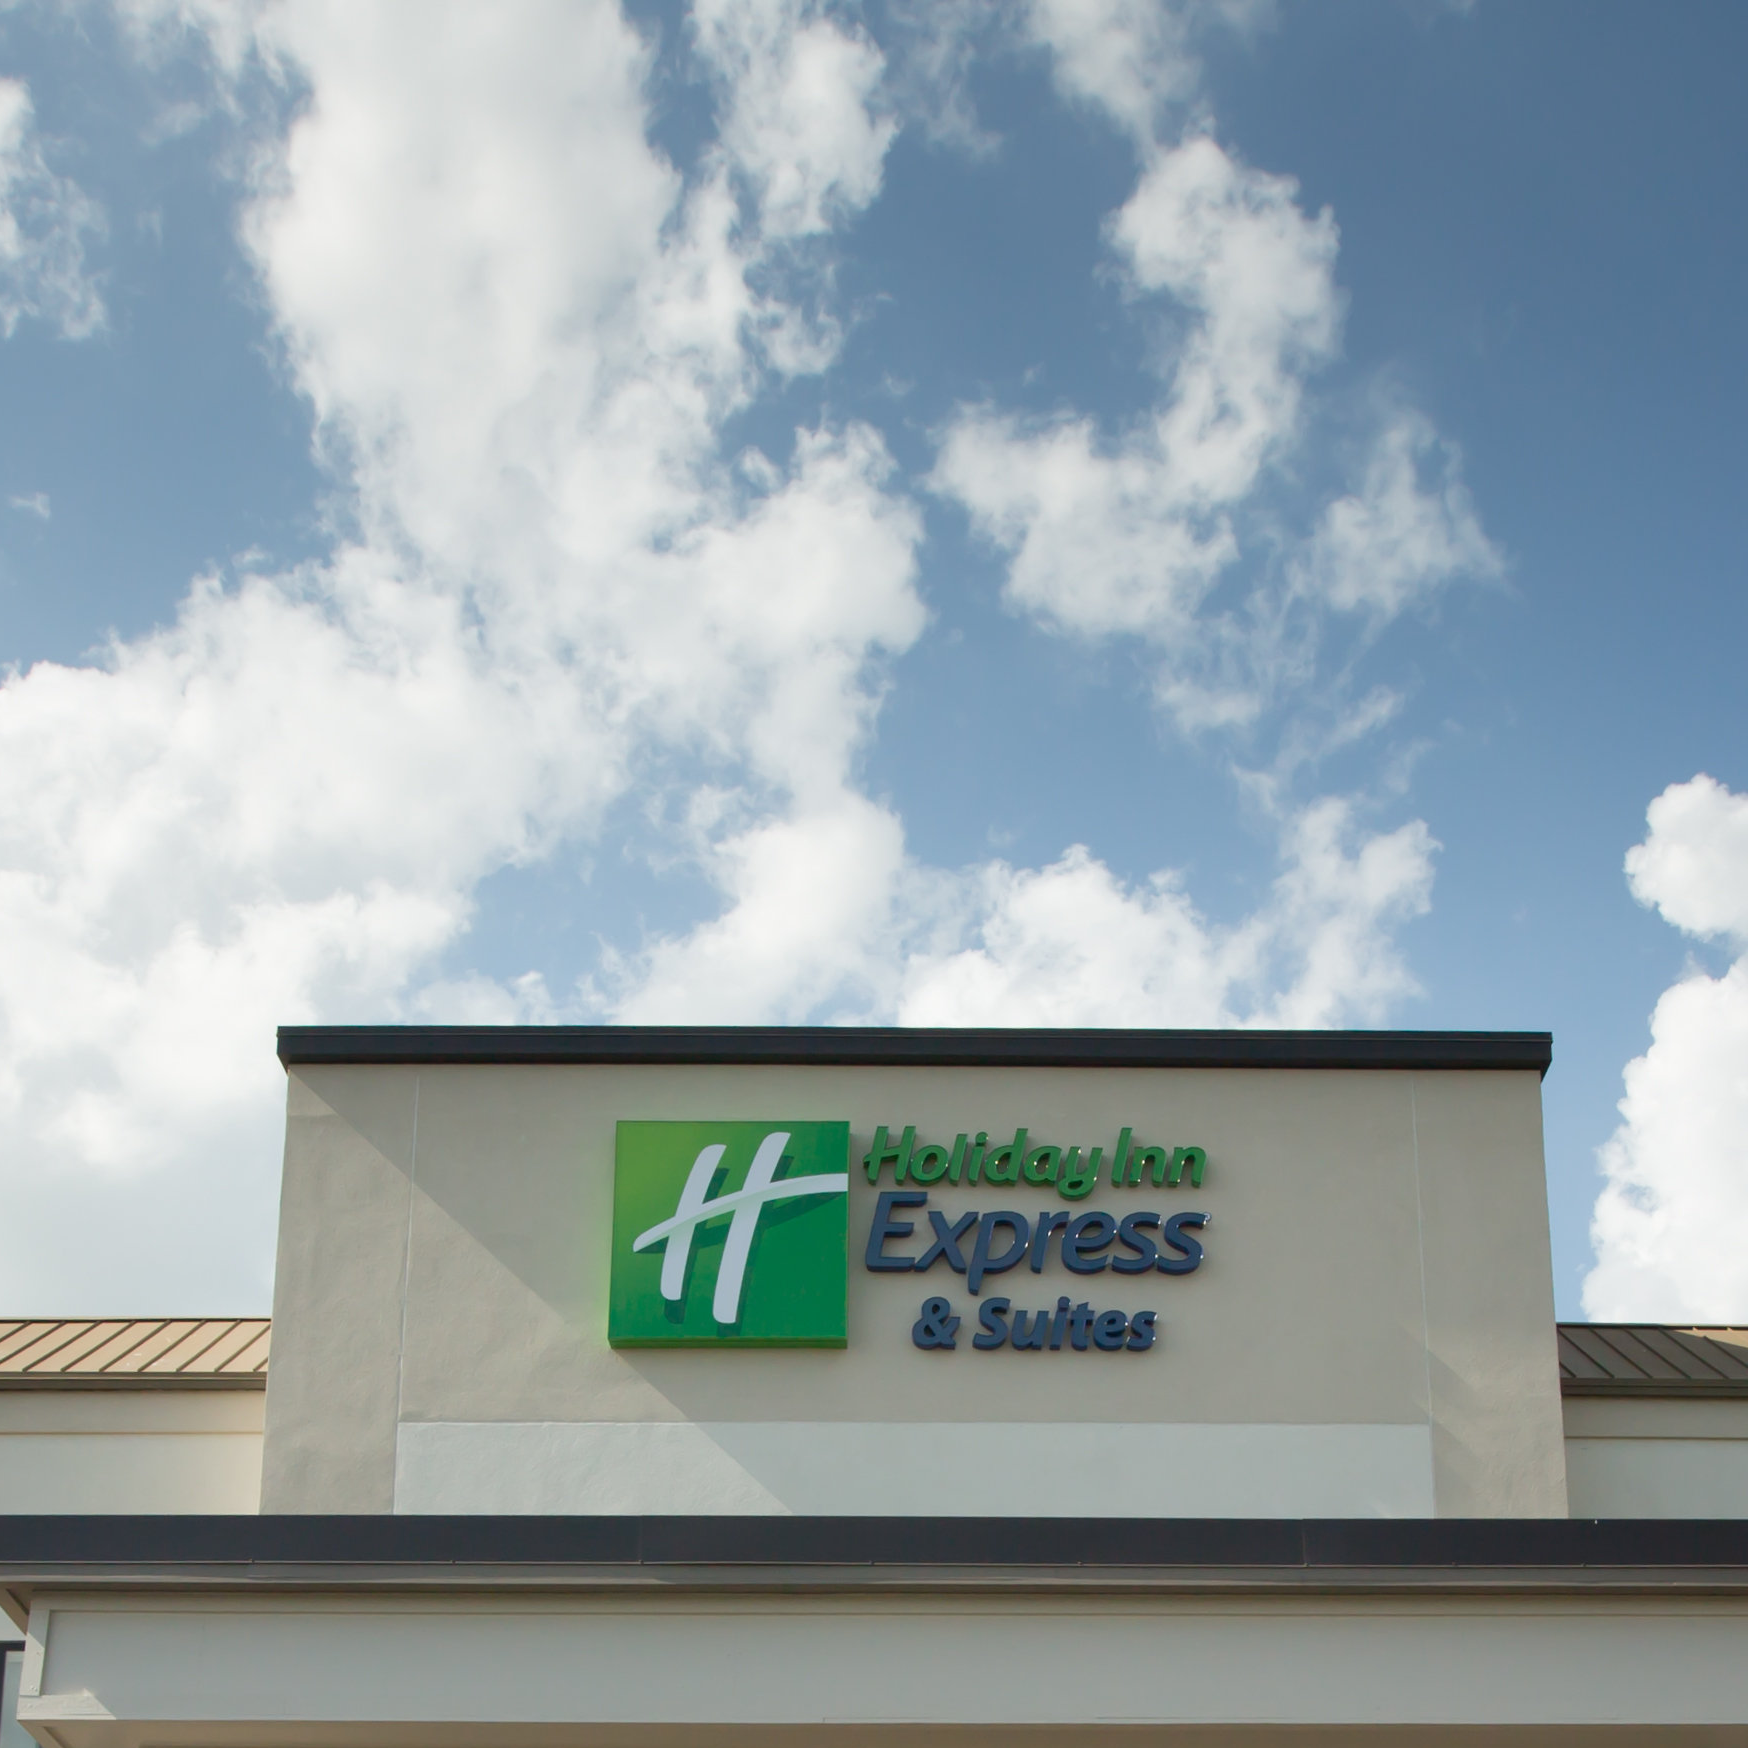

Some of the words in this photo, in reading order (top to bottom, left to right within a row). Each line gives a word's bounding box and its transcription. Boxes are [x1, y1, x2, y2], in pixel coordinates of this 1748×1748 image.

[863, 1126, 1103, 1200] Holiday
[1111, 1127, 1207, 1188] Inn
[865, 1191, 1206, 1296] Express
[912, 1296, 961, 1350] &
[972, 1296, 1157, 1350] Suites
